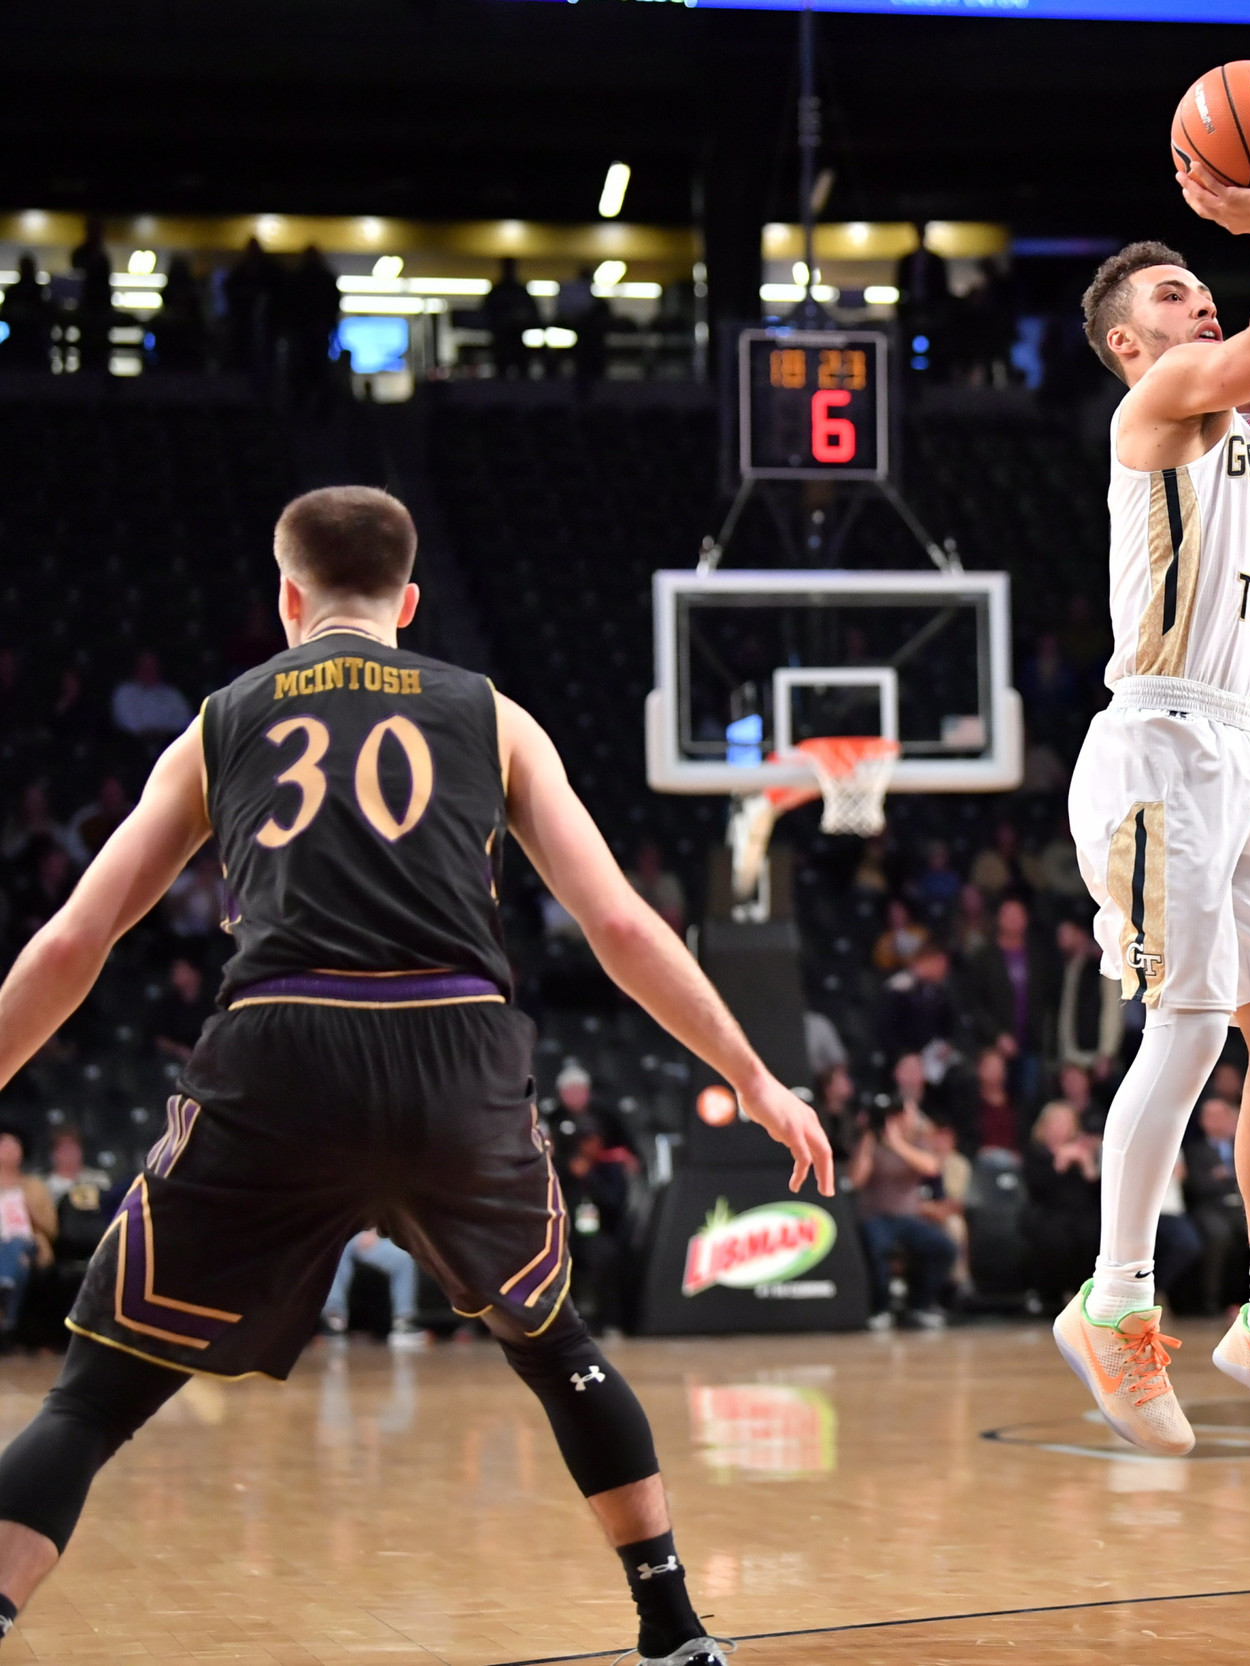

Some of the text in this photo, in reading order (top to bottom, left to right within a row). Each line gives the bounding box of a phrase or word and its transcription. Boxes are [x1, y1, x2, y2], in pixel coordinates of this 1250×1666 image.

[811, 389, 856, 463] 6
[273, 657, 423, 700] MCINTOSH
[255, 712, 435, 849] 30
[1126, 941, 1163, 977] GT
